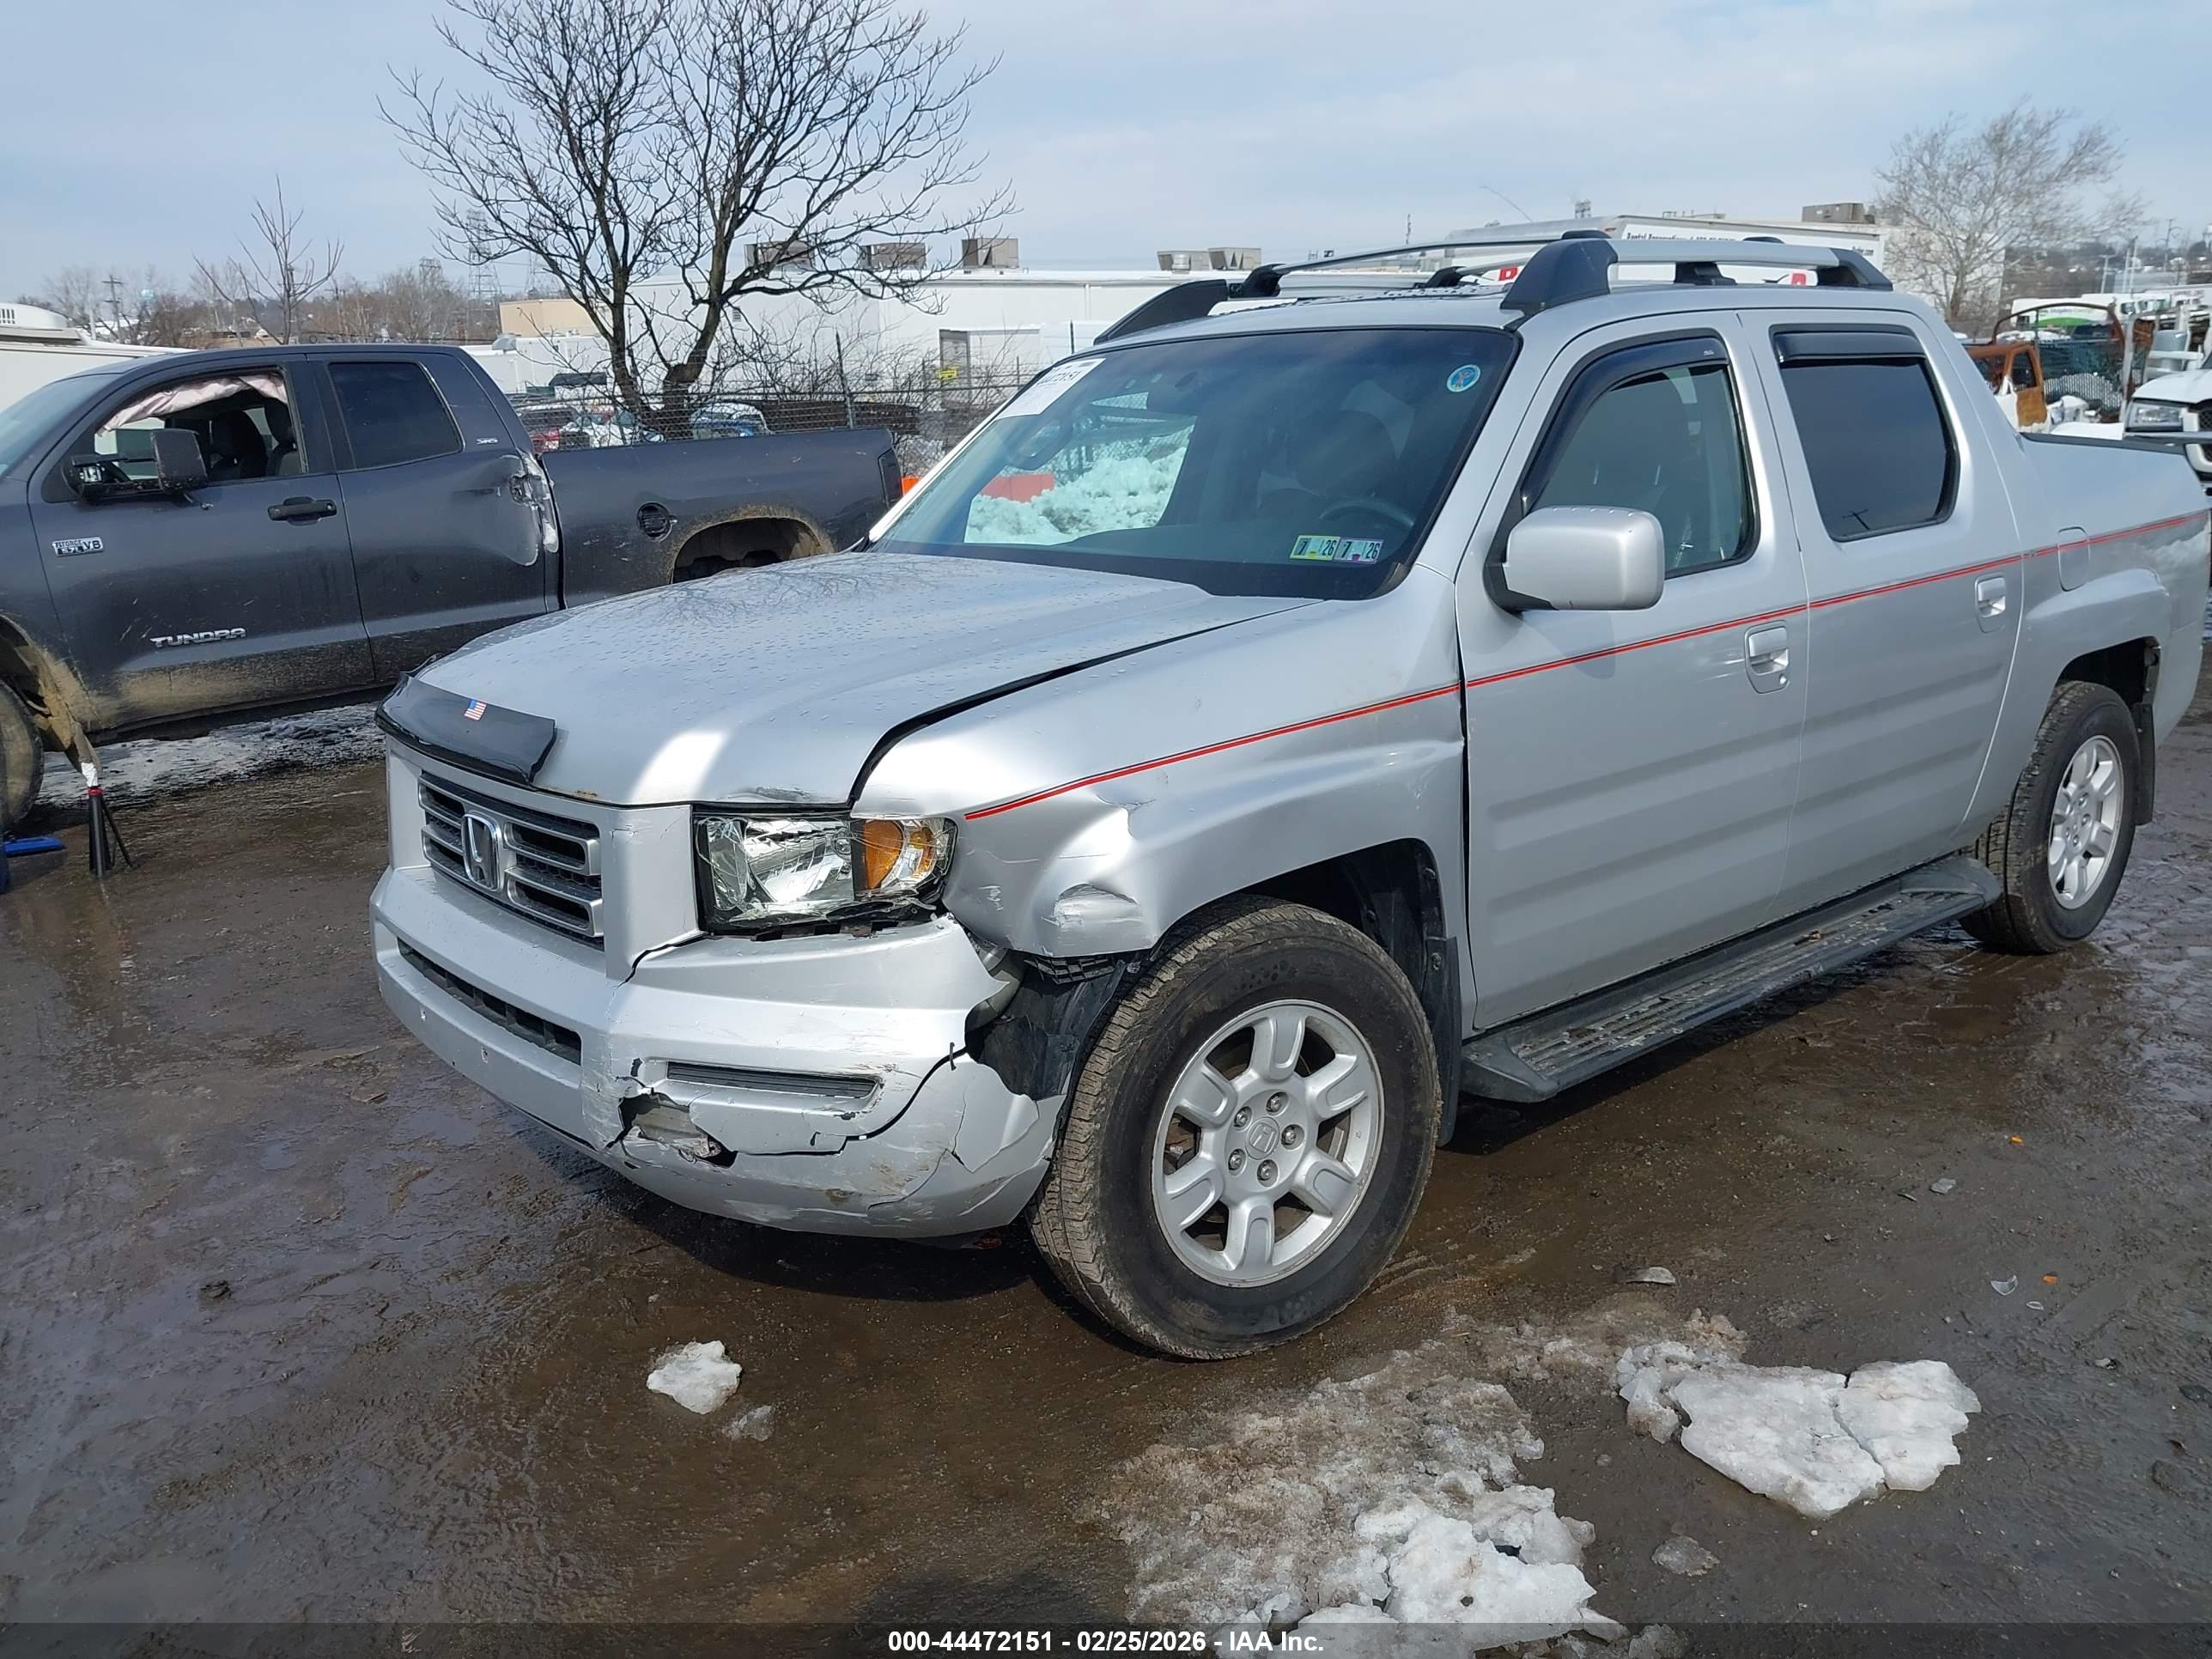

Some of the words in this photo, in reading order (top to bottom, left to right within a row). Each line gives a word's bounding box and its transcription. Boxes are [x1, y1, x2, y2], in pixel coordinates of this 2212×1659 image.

[1297, 541, 1309, 556] 7
[1322, 539, 1338, 556] 26
[1341, 541, 1352, 558] 7
[1365, 542, 1381, 560] 26
[149, 627, 246, 648] TUNDRA
